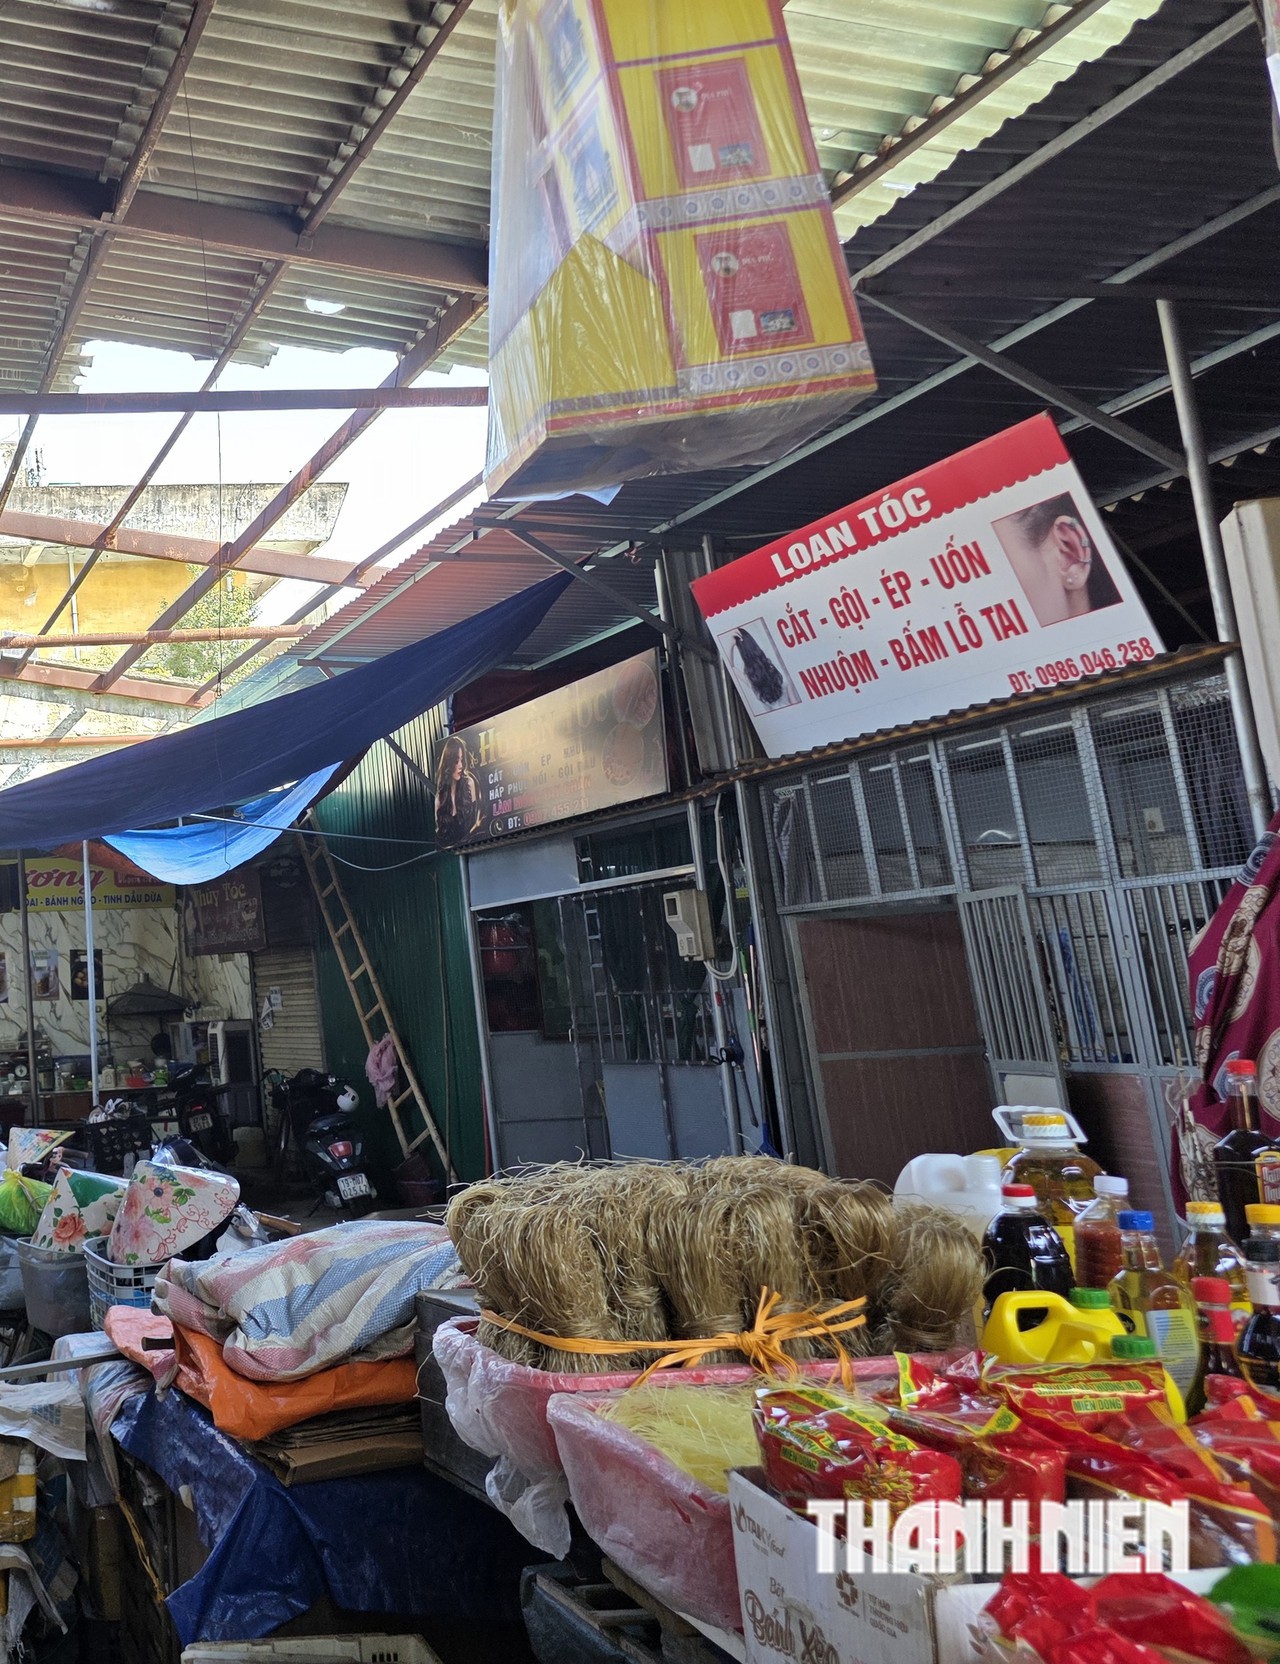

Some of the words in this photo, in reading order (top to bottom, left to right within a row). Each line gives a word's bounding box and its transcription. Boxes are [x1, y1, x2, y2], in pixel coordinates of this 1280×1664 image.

[770, 520, 858, 579] LOAN
[857, 487, 933, 537] TÓC
[776, 602, 818, 649] CẮT
[829, 586, 871, 631] GỘI
[880, 568, 912, 609] ÉP
[929, 534, 992, 590] UỐN
[798, 649, 880, 701] NHUỘM
[888, 619, 950, 672] BẤM
[944, 601, 984, 654] LỖ
[978, 598, 1030, 642] TAI
[1035, 636, 1156, 686] 0986.046.258
[46, 895, 69, 907] BÁNH
[71, 895, 97, 905] NGO
[104, 895, 122, 904] TINH
[124, 889, 143, 904] DẦU
[144, 890, 163, 903] DỪA
[744, 1589, 796, 1657] Bánh
